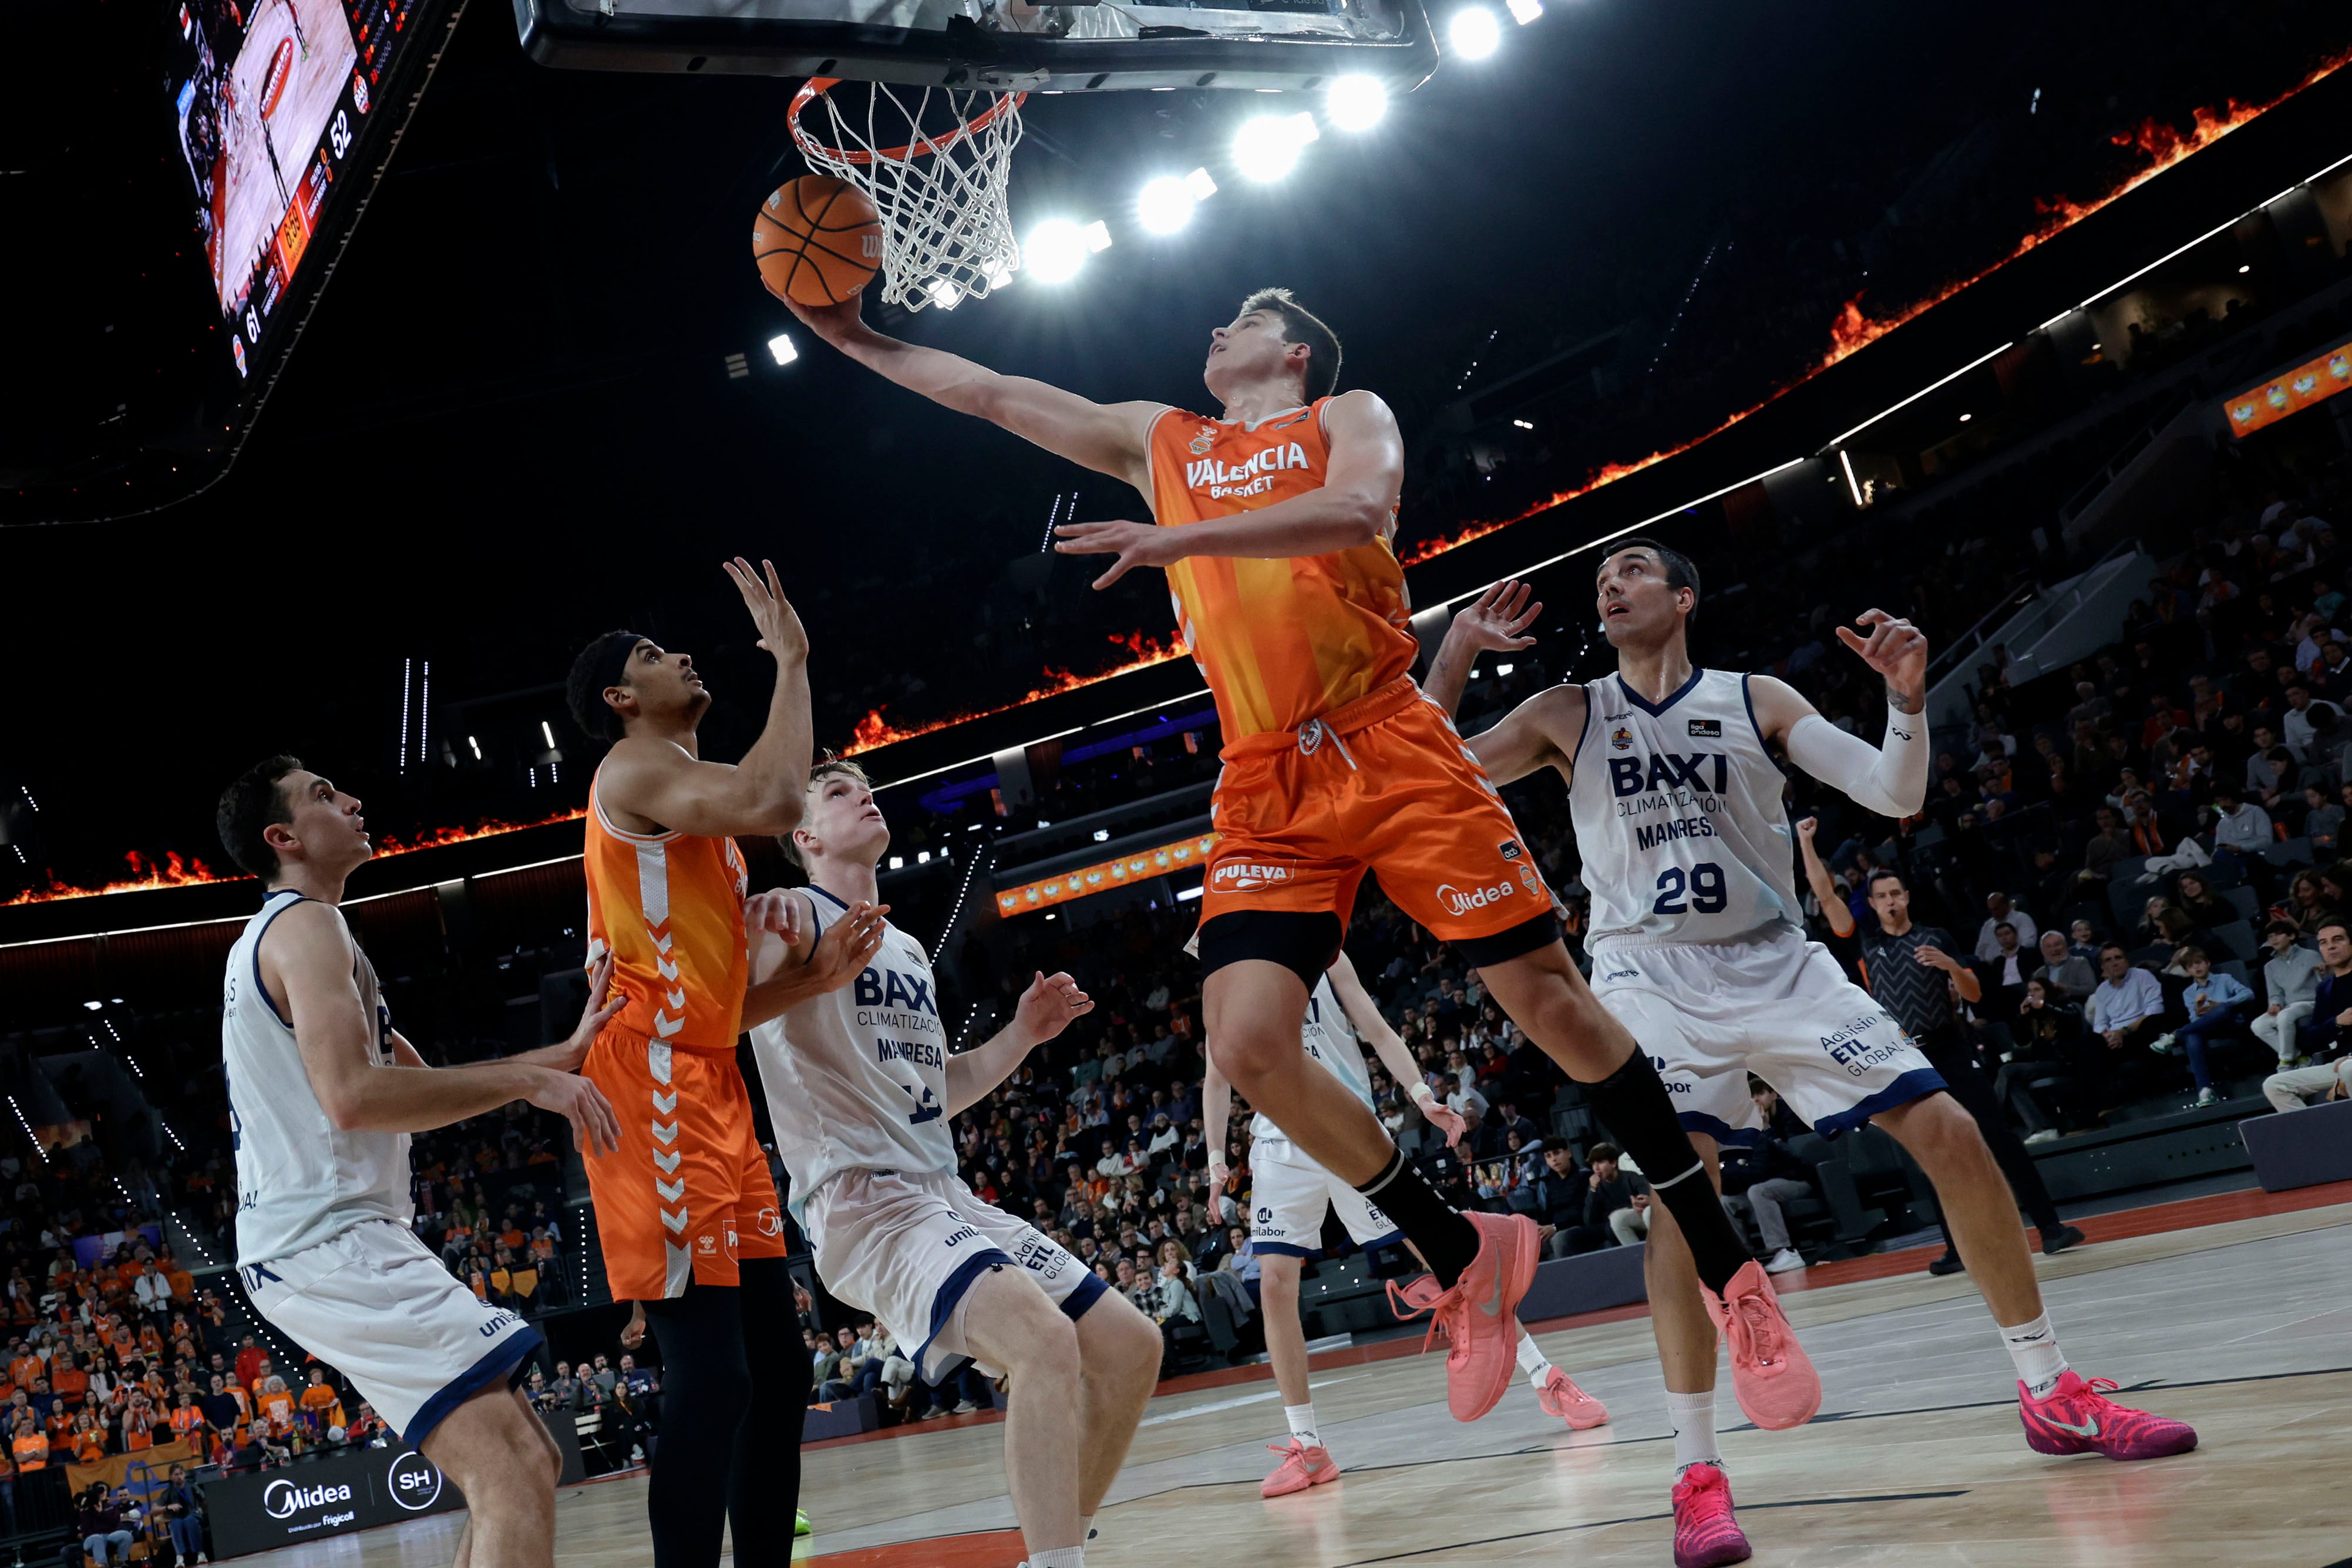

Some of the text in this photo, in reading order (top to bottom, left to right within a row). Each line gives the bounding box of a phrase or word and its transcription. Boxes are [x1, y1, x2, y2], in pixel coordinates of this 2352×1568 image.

[385, 9, 390, 23] 6
[330, 110, 352, 160] 52
[246, 304, 261, 344] 61
[1186, 442, 1308, 490] VALENCIA
[1210, 475, 1275, 500] BASKET
[1607, 752, 1728, 798] BAXI
[1616, 791, 1727, 817] CLIMATIZAIÓN
[1636, 816, 1718, 852] MANRES
[1214, 864, 1287, 883] PULEVA
[1653, 862, 1728, 915] 29
[1436, 881, 1514, 916] Midea
[853, 967, 938, 1017] BAX
[1820, 1016, 1877, 1051] Adbisio
[877, 1038, 943, 1071] MANRESA
[1830, 1039, 1871, 1066] ETL
[1848, 1041, 1905, 1076] GLOBAL
[1251, 1226, 1286, 1237] nilabor
[1025, 1246, 1055, 1271] ETL
[1044, 1250, 1071, 1280] GLOB
[479, 1311, 521, 1337] unila
[399, 1469, 430, 1490] SH
[264, 1479, 352, 1519] Midea
[322, 1510, 355, 1527] frigicoll
